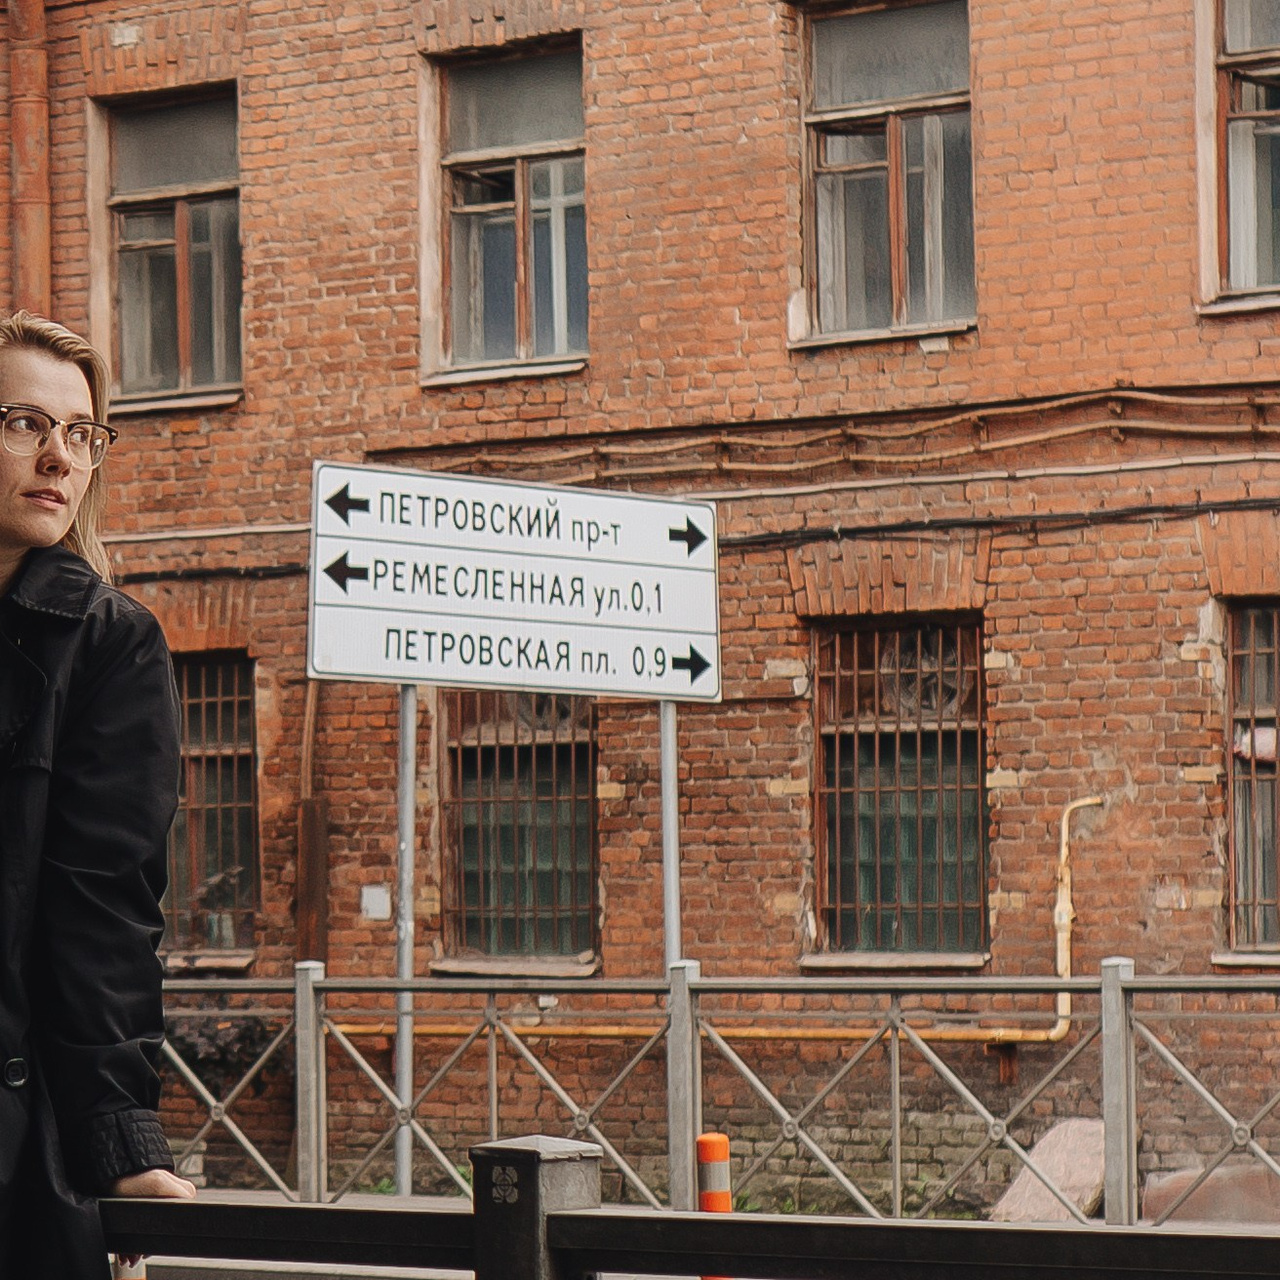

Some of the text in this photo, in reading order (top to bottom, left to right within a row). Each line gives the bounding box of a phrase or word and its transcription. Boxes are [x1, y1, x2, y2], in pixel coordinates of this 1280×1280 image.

[379, 492, 621, 552] ПЕТРОВСКИЙ пр-т
[373, 560, 584, 607] РЕМЕСЛЕННАЯ
[385, 628, 667, 679] ПЕТРОВСКАЯ пл. 0,9
